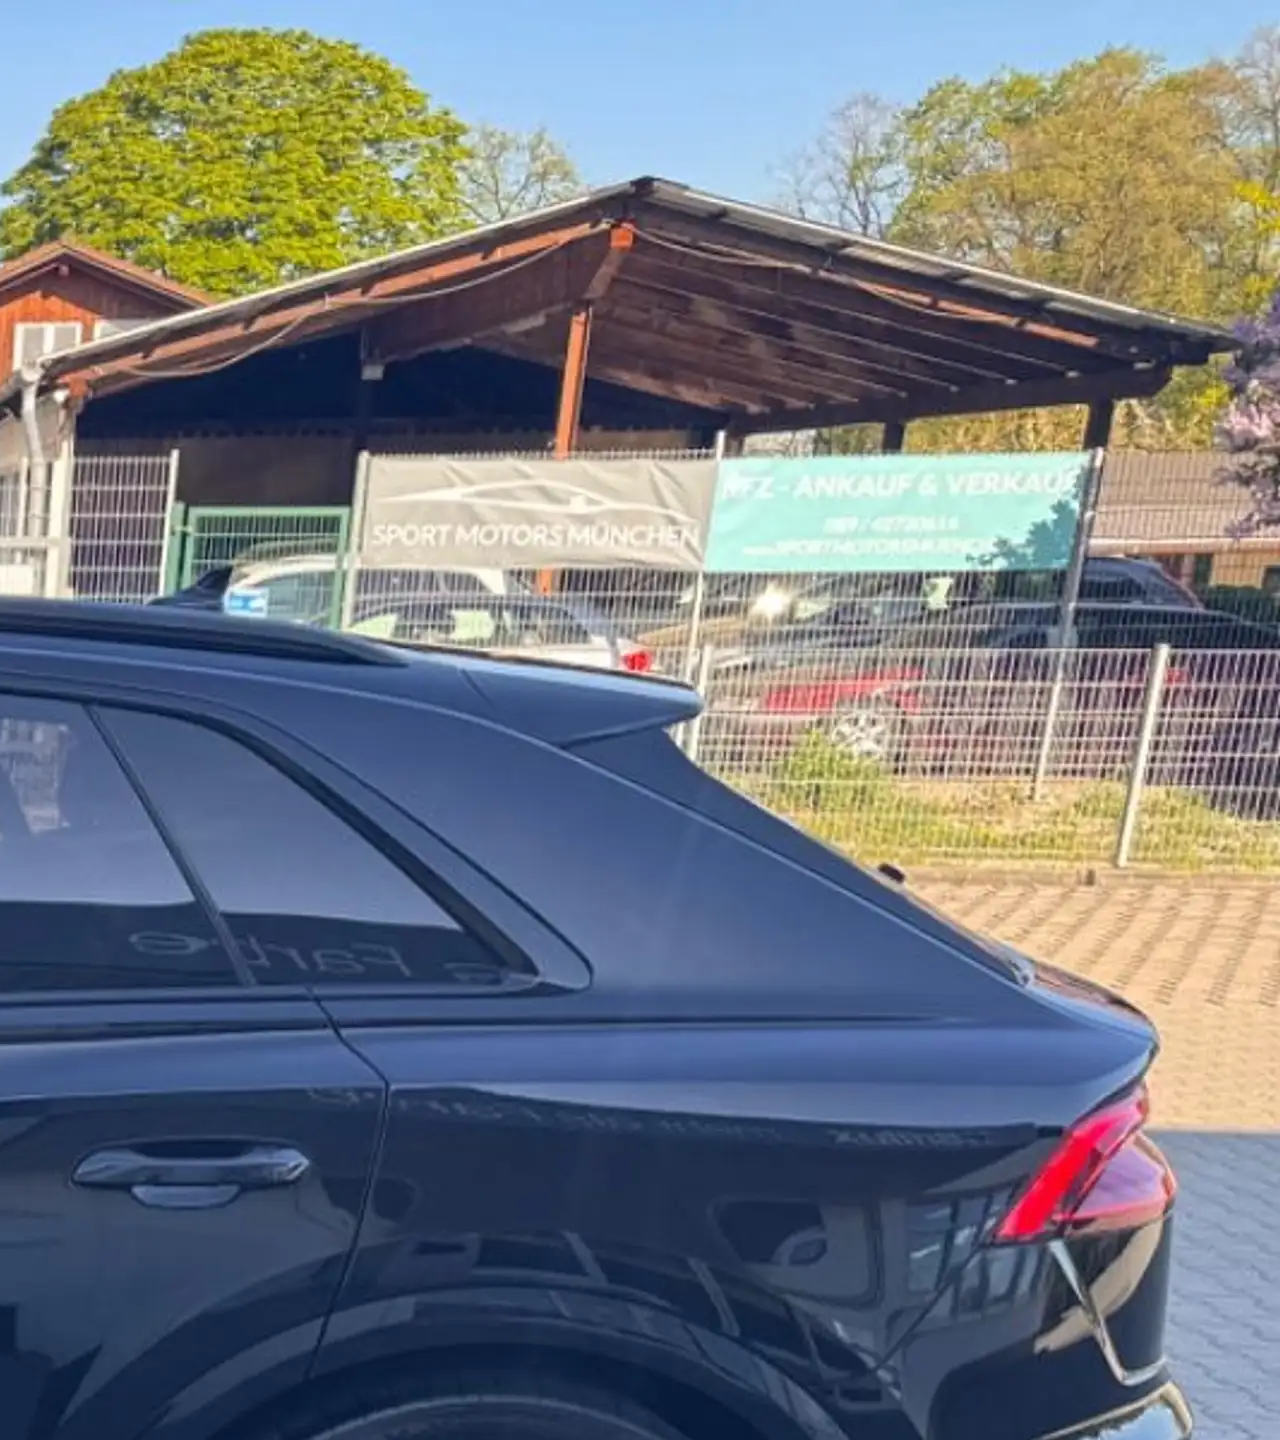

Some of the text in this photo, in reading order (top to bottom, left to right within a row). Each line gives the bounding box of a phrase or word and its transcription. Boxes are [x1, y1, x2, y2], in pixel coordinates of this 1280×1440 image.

[793, 473, 914, 499] ANKAUF
[917, 474, 938, 497] &
[371, 520, 700, 549] SPORT MOTORS MÜNCHEN
